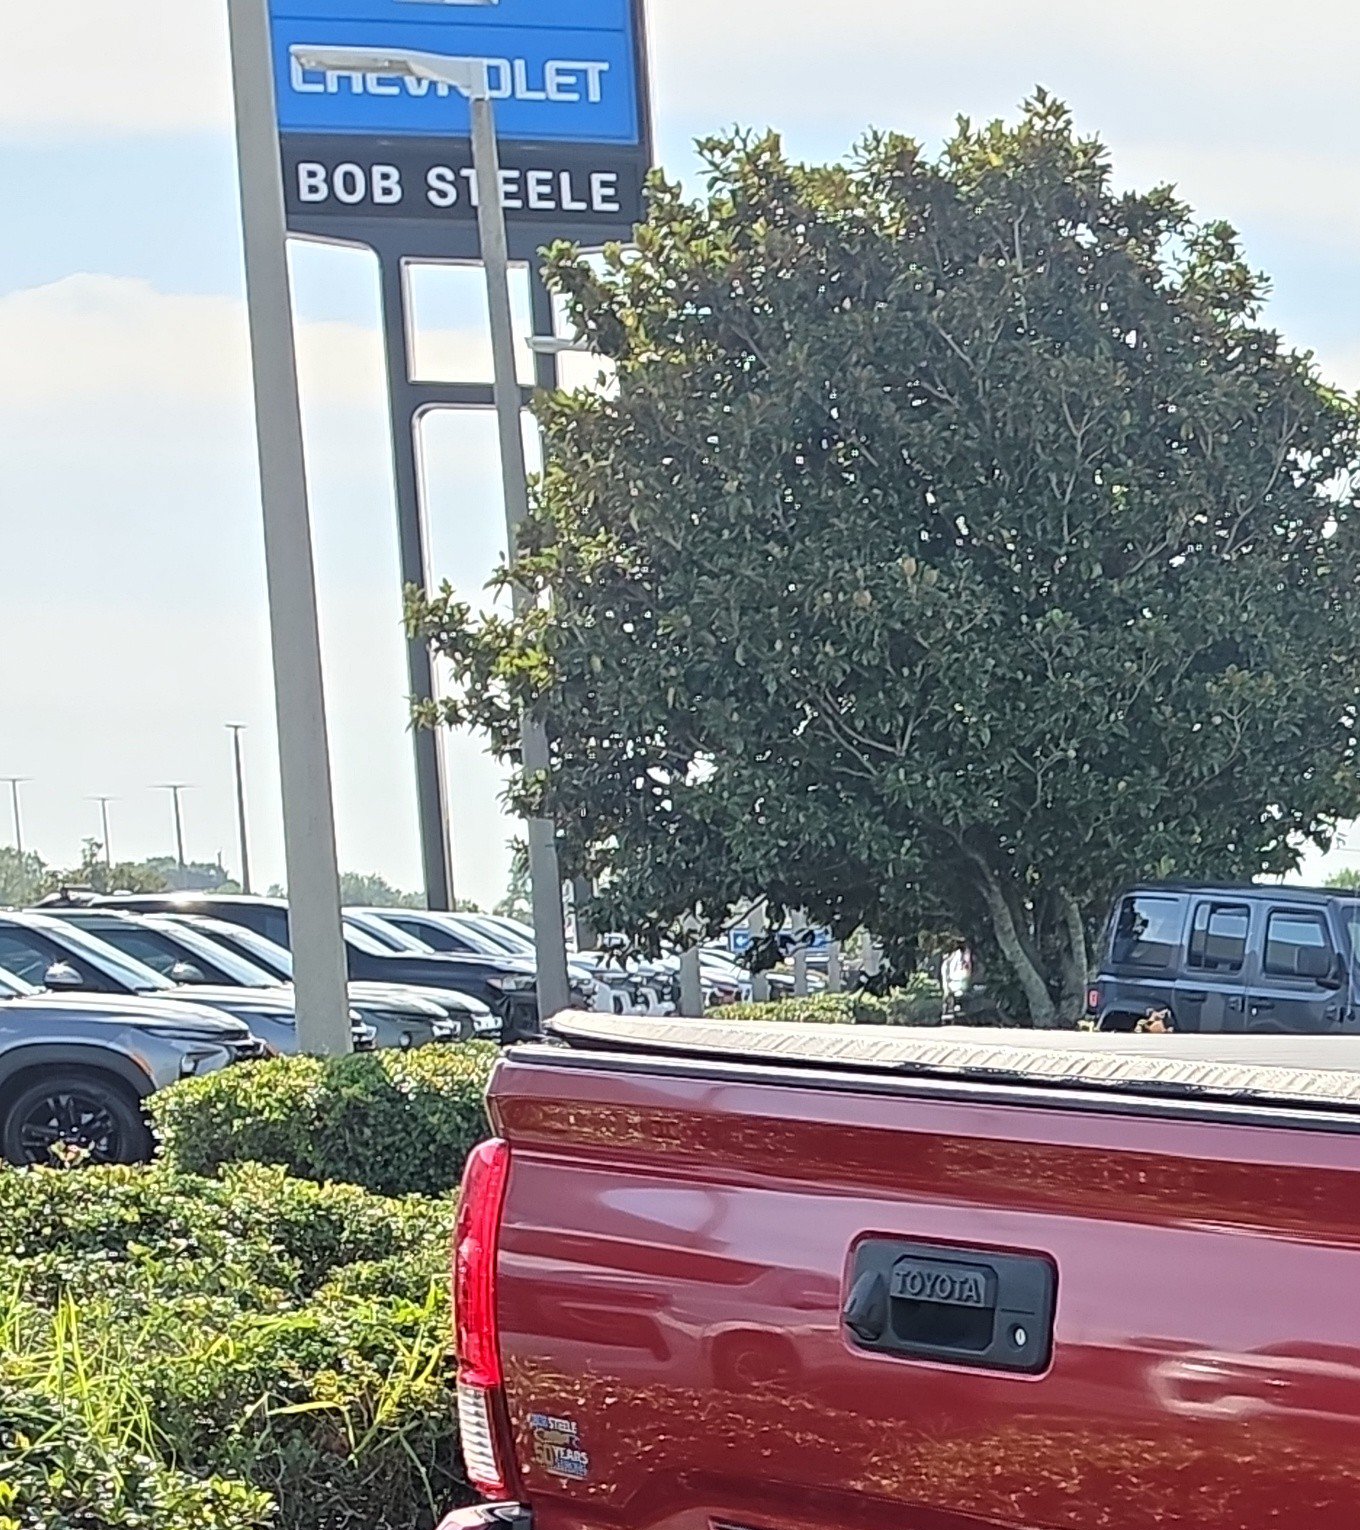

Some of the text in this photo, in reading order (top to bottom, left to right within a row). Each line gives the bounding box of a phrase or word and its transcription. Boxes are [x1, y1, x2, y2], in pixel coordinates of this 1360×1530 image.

[297, 162, 620, 212] BOB STEELE
[896, 1270, 981, 1304] TOYOTA
